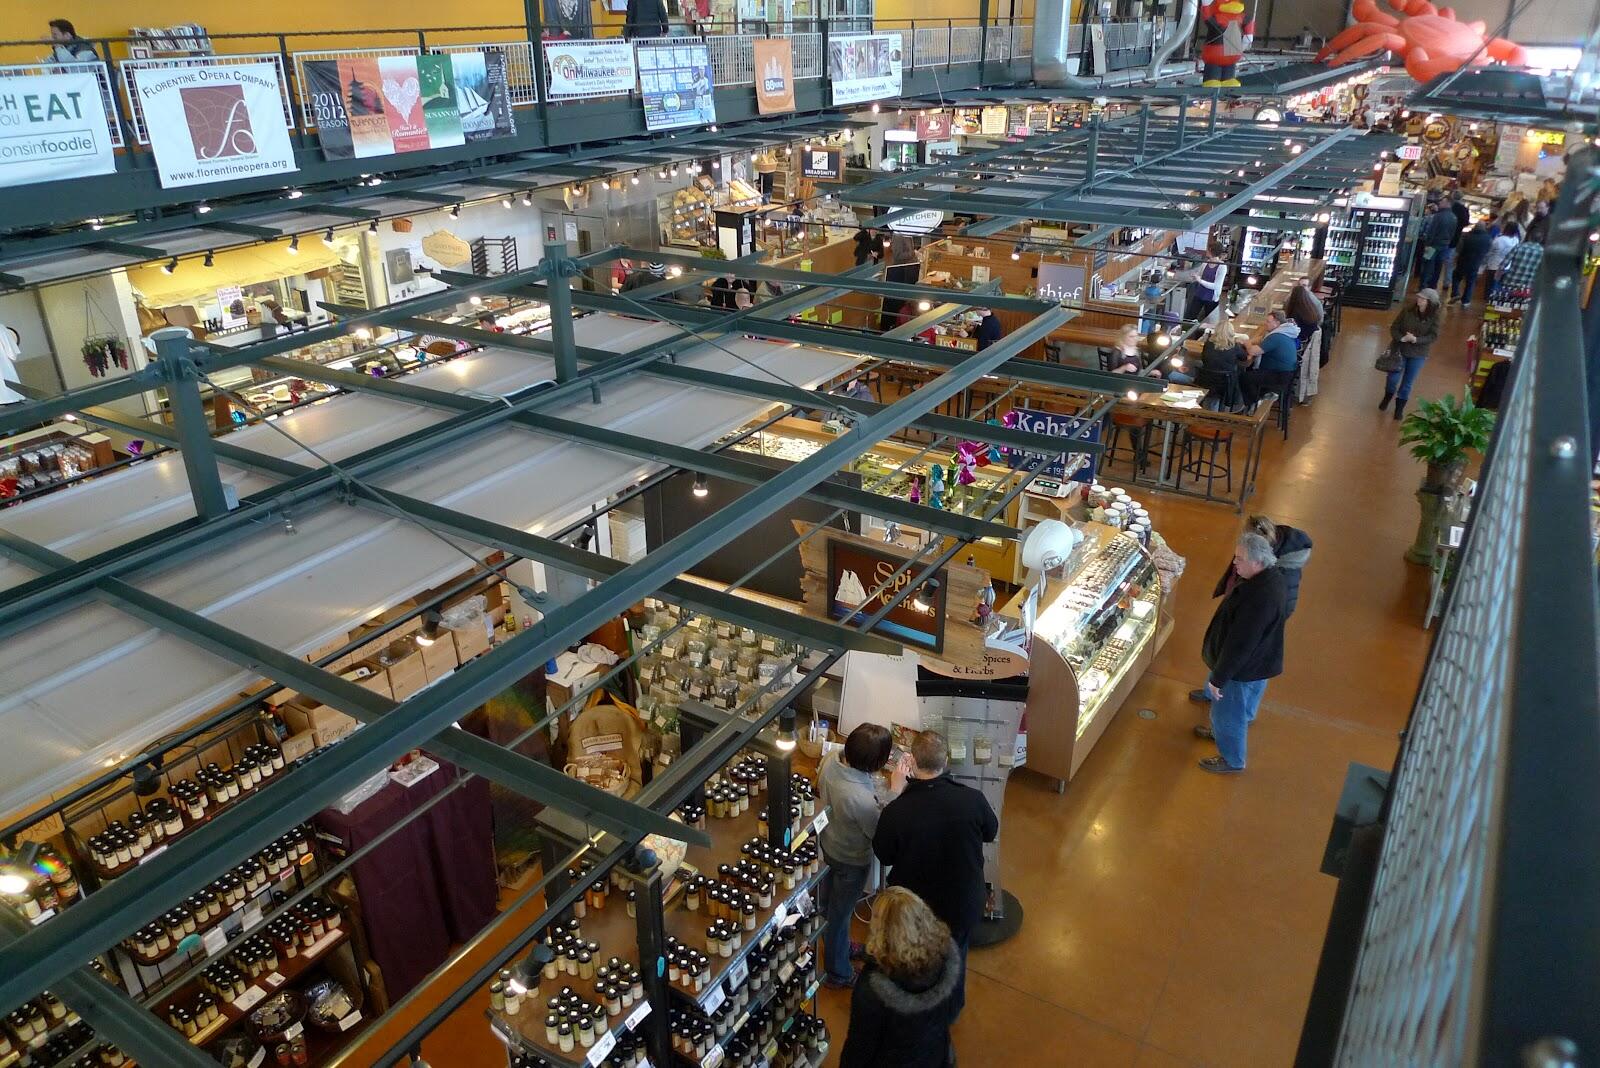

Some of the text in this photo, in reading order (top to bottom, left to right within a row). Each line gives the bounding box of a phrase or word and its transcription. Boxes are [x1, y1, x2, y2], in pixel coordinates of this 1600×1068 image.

[142, 70, 276, 99] FLORENTINE OPERA COMPANY
[312, 93, 341, 107] 2011
[24, 92, 83, 123] EAT
[315, 106, 346, 120] 2012
[318, 119, 348, 129] SEASON
[1404, 147, 1420, 159] EXIT
[170, 159, 288, 182] www.florentineopera.org
[1040, 283, 1083, 300] thief
[939, 338, 974, 350] Trfles
[874, 561, 928, 593] Spi
[983, 653, 1011, 665] Spices
[952, 666, 961, 674] &
